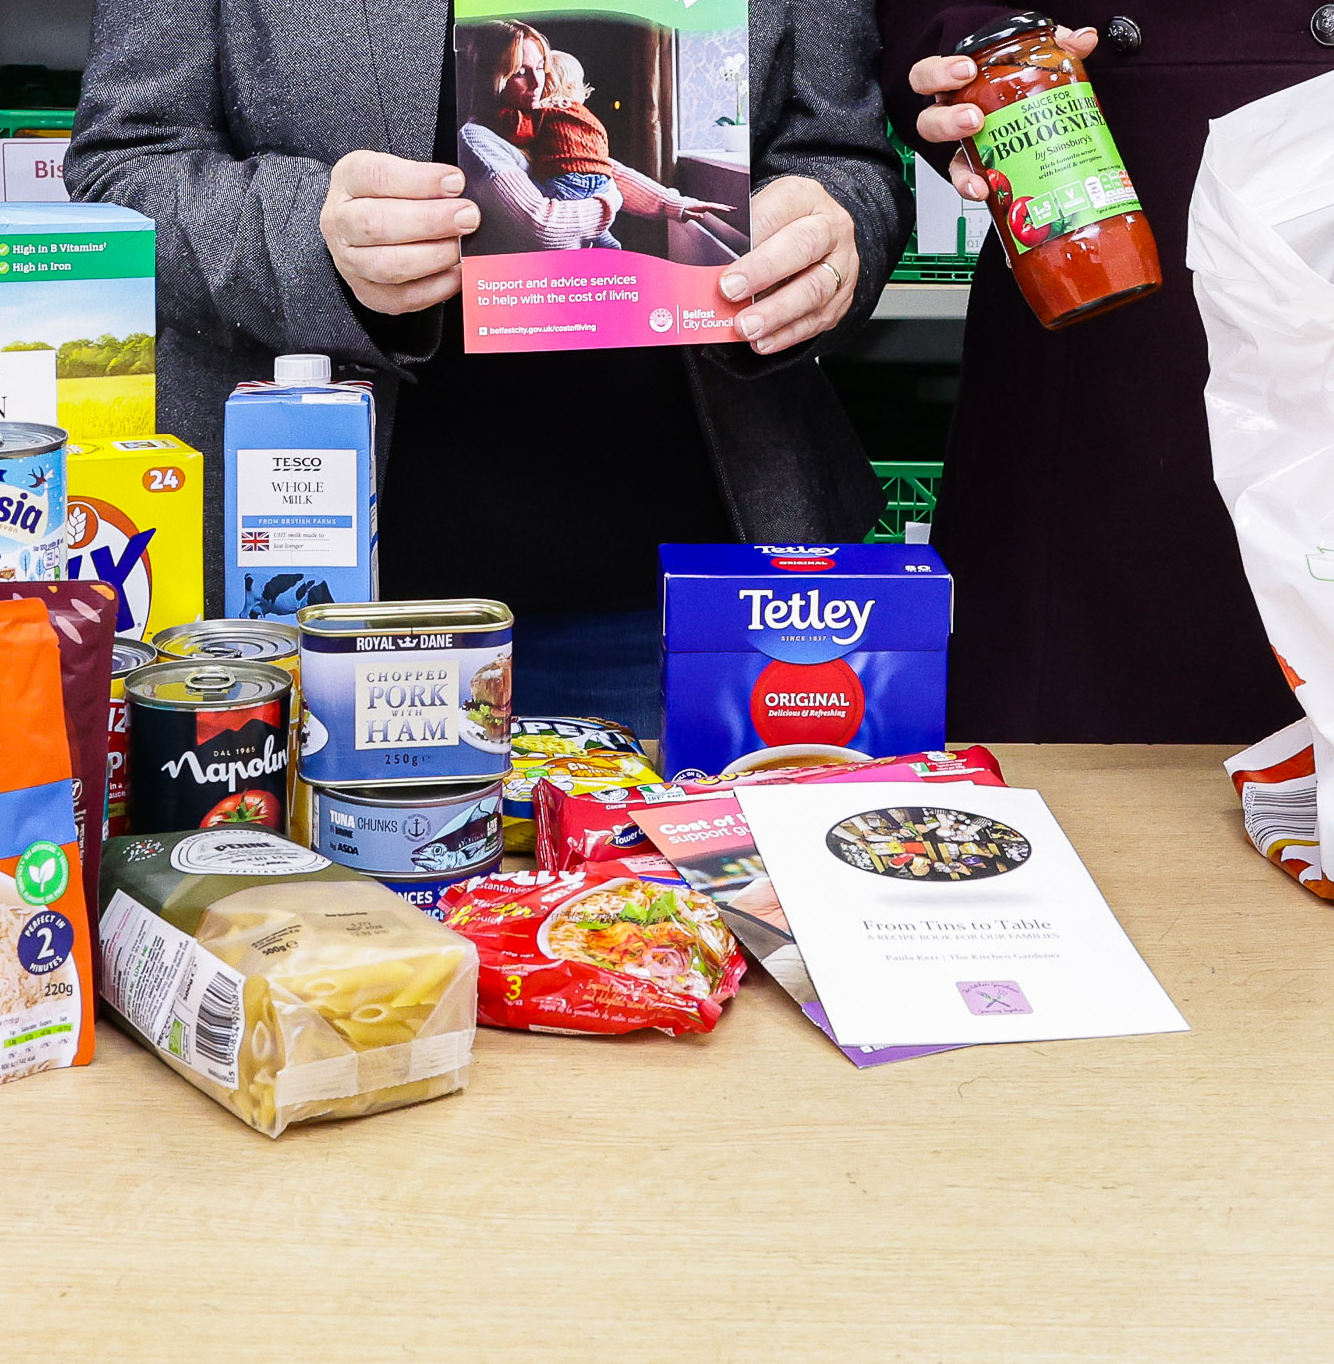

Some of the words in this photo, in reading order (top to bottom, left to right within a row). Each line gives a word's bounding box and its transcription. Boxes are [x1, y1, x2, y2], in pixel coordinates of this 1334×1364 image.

[1021, 96, 1052, 113] SAUCE
[1053, 91, 1071, 101] FOR
[272, 457, 321, 467] TESCO
[272, 482, 324, 493] WHOLE
[739, 590, 875, 645] Tetley
[357, 637, 395, 651] ROYAL
[420, 634, 453, 649] DANE
[367, 684, 448, 709] PORK
[765, 693, 849, 706] ORIGINAL
[366, 718, 449, 744] HAM
[385, 753, 418, 766] 250g
[329, 810, 355, 829] TUNA
[357, 813, 398, 833] CHUNKS
[863, 921, 916, 931] From
[920, 920, 966, 930] Tins
[971, 921, 991, 930] to
[995, 920, 1052, 930] Table
